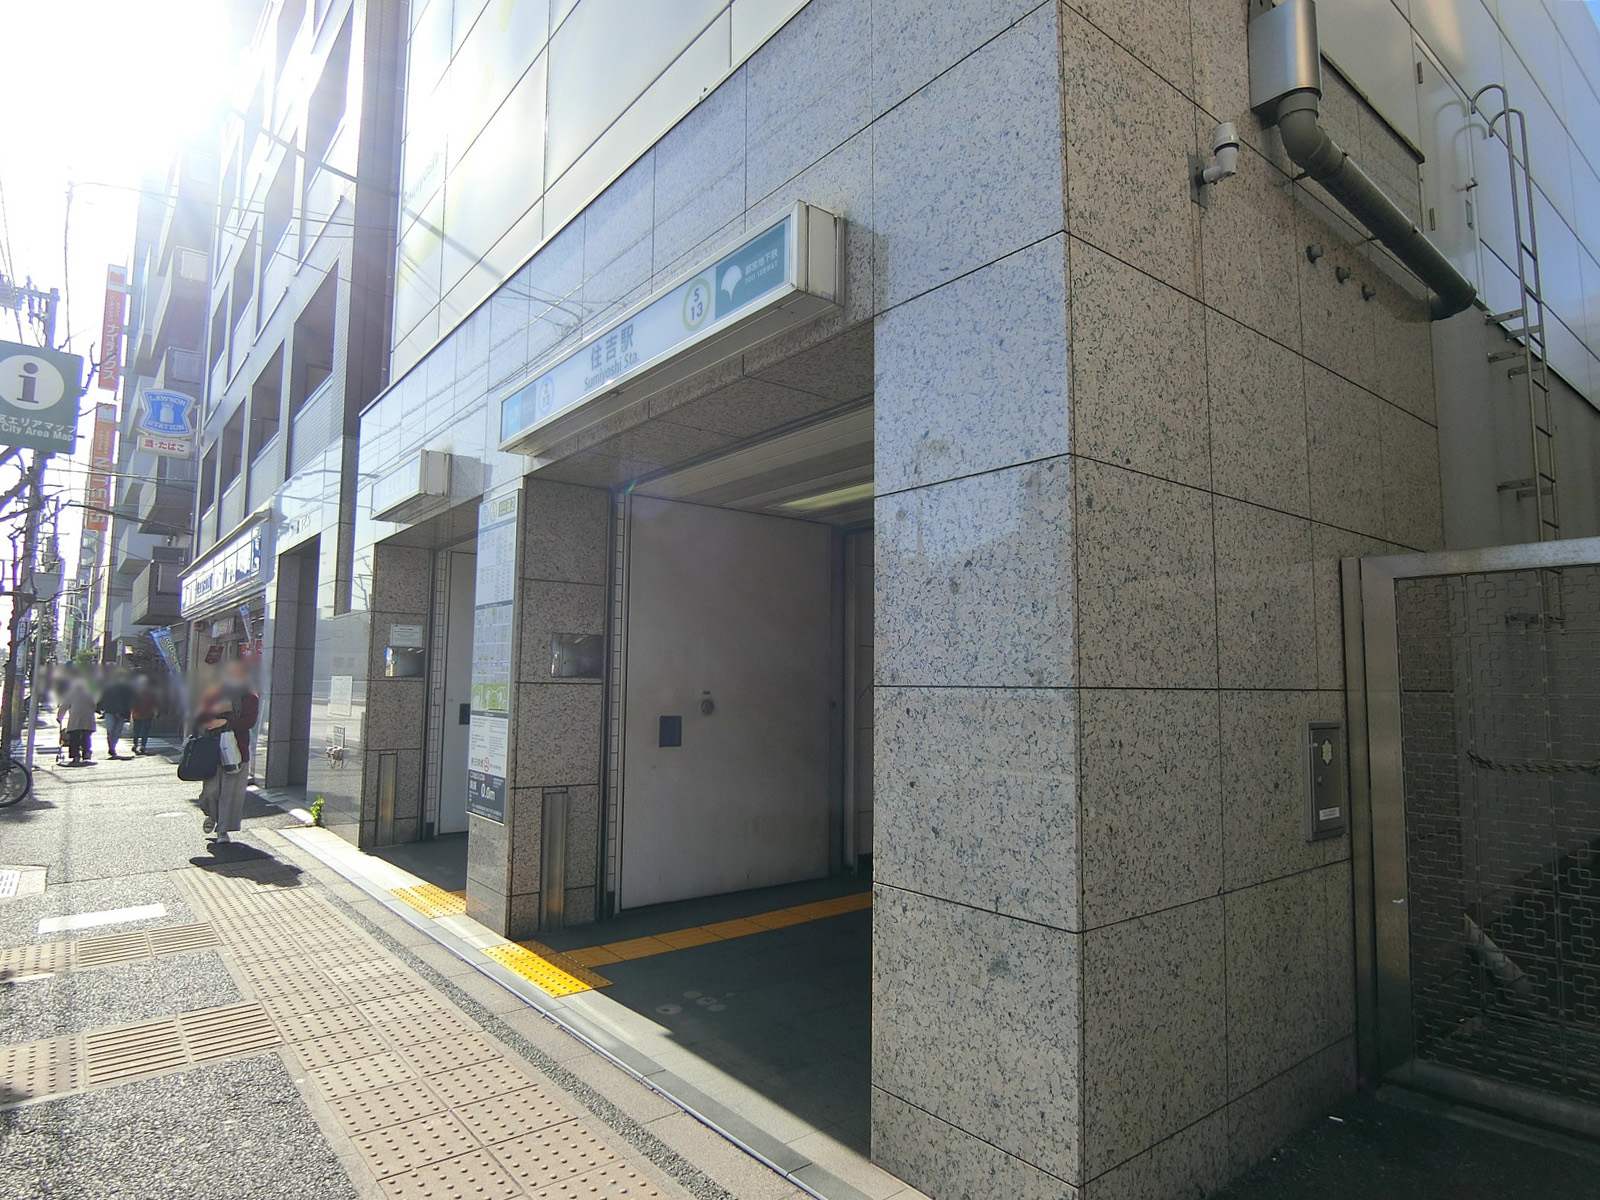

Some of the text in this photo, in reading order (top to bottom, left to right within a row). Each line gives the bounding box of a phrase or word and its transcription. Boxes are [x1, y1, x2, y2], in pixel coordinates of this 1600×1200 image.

[693, 287, 700, 303] S
[690, 301, 704, 321] 13
[590, 323, 634, 371] 住吉駅
[583, 351, 640, 391] Sumiyoshi Sta.
[149, 394, 187, 407] LAWSON
[1, 423, 75, 442] City Area Map
[147, 420, 185, 431] STATION
